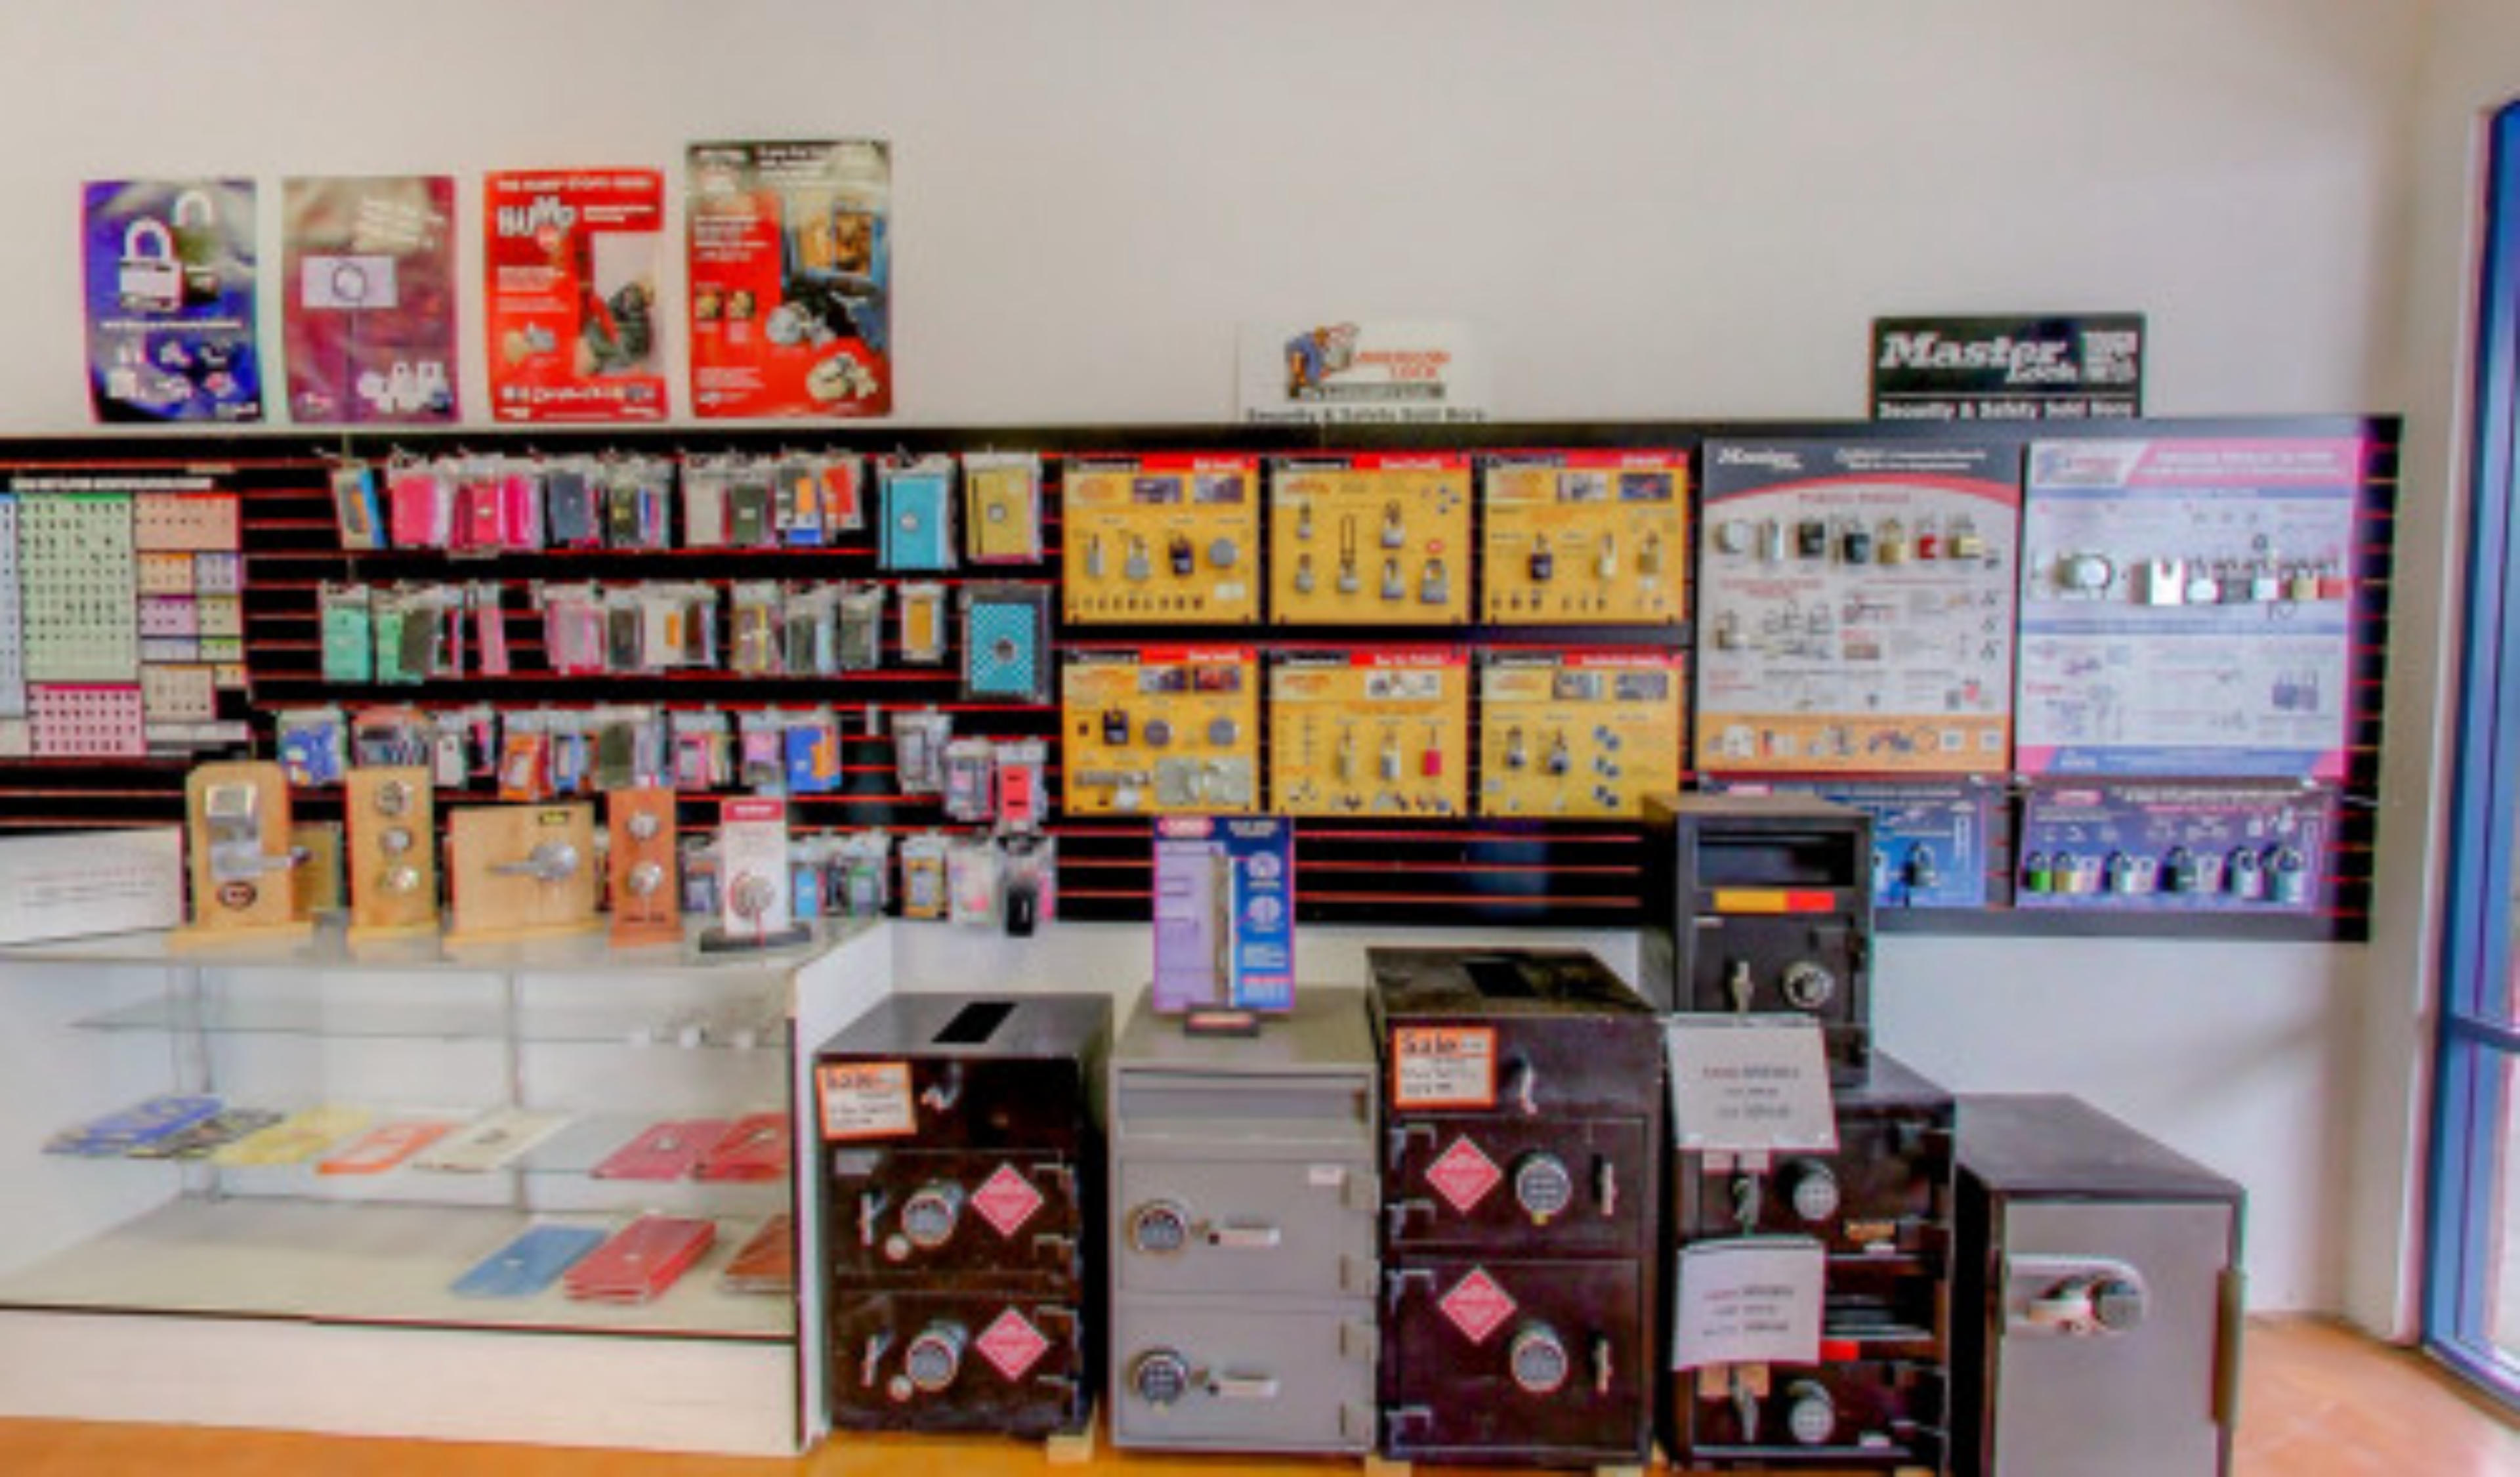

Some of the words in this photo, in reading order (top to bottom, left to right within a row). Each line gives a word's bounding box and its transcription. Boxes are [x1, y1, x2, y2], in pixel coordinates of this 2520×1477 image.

[1879, 331, 2068, 369] Master
[2006, 361, 2076, 384] Lock
[1960, 401, 1975, 418] &
[1981, 401, 2040, 419] Safety
[1400, 1027, 1456, 1054] Sale
